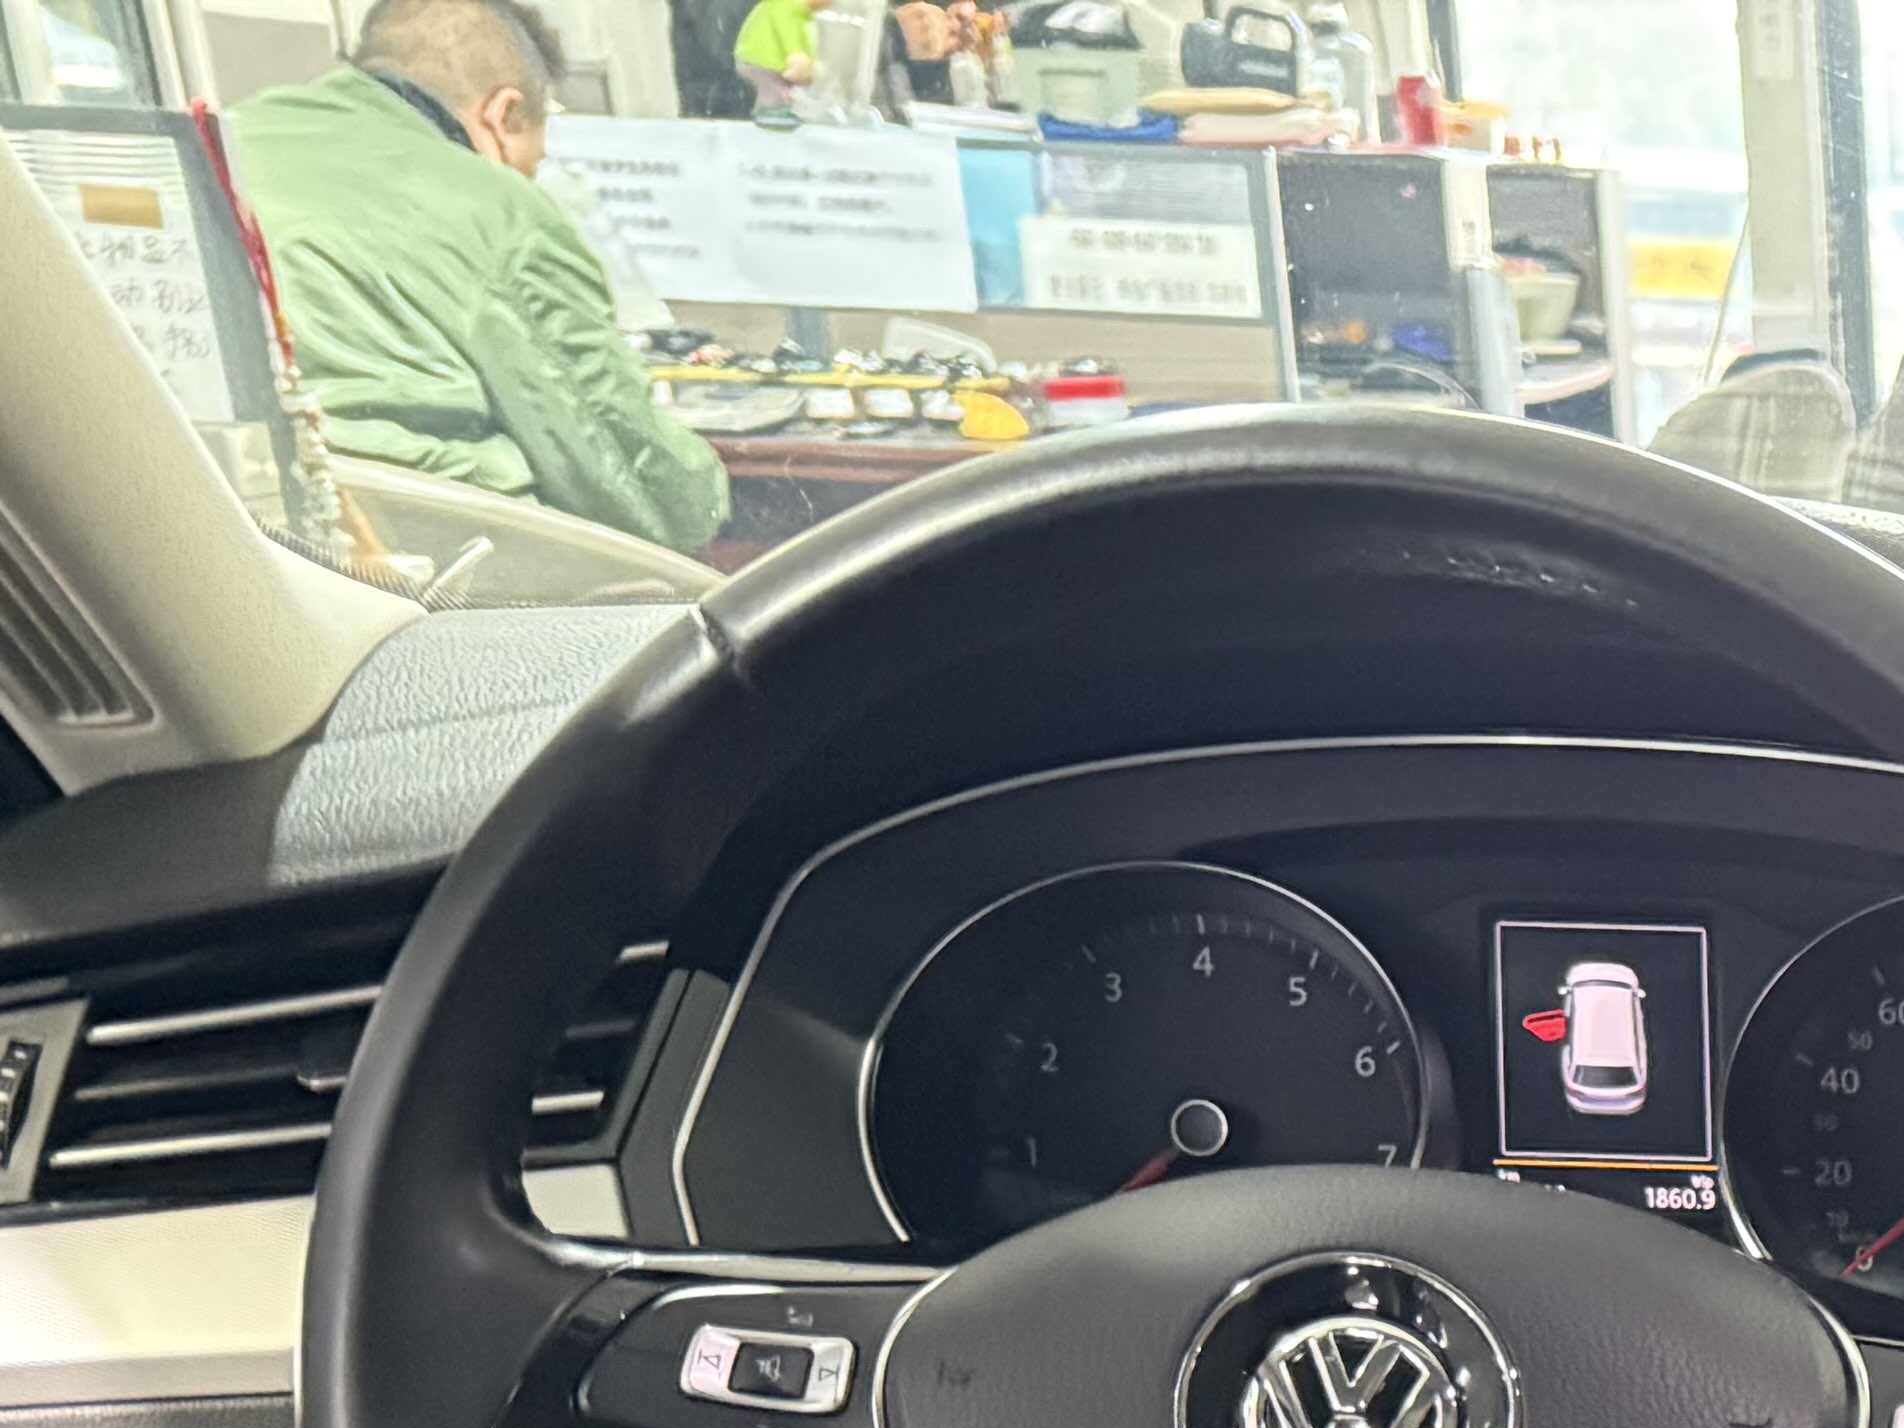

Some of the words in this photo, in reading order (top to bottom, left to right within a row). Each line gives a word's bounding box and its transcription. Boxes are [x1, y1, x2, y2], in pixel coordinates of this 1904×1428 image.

[1192, 947, 1215, 976] 4
[1104, 974, 1122, 1001] 3
[1289, 978, 1306, 1006] 5
[1040, 1042, 1059, 1072] 2
[1355, 1047, 1375, 1076] 6
[1821, 1067, 1859, 1094] 40
[1378, 1145, 1398, 1167] 7
[1815, 1160, 1852, 1186] 20
[1645, 1187, 1716, 1209] 1860.9
